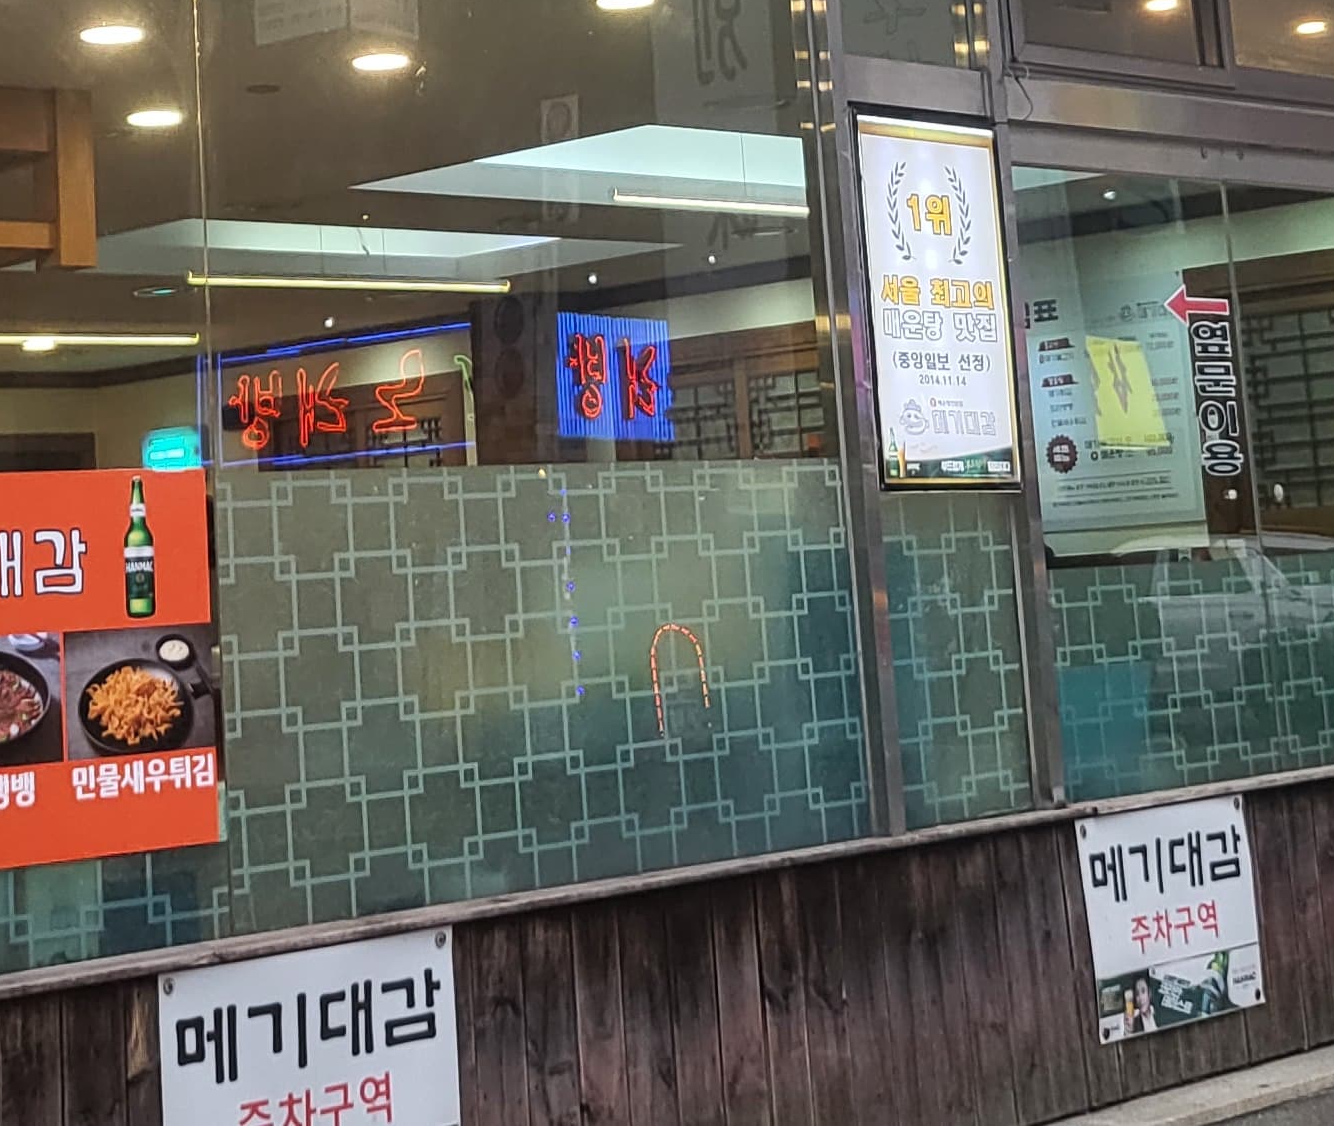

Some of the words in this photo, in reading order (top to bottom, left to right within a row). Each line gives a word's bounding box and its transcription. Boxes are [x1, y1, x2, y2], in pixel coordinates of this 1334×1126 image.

[906, 192, 953, 236] 1위
[881, 275, 922, 306] 서울
[930, 278, 995, 310] 최고의
[882, 308, 943, 341] 매운탕
[953, 312, 998, 342] 맛집
[892, 351, 951, 372] (중앙일보
[958, 354, 992, 373] 선정)
[70, 754, 216, 801] 민물새우튀김
[1089, 824, 1242, 903] 메기대감
[1130, 899, 1220, 954] 주차구역
[175, 967, 442, 1084] 메기대감
